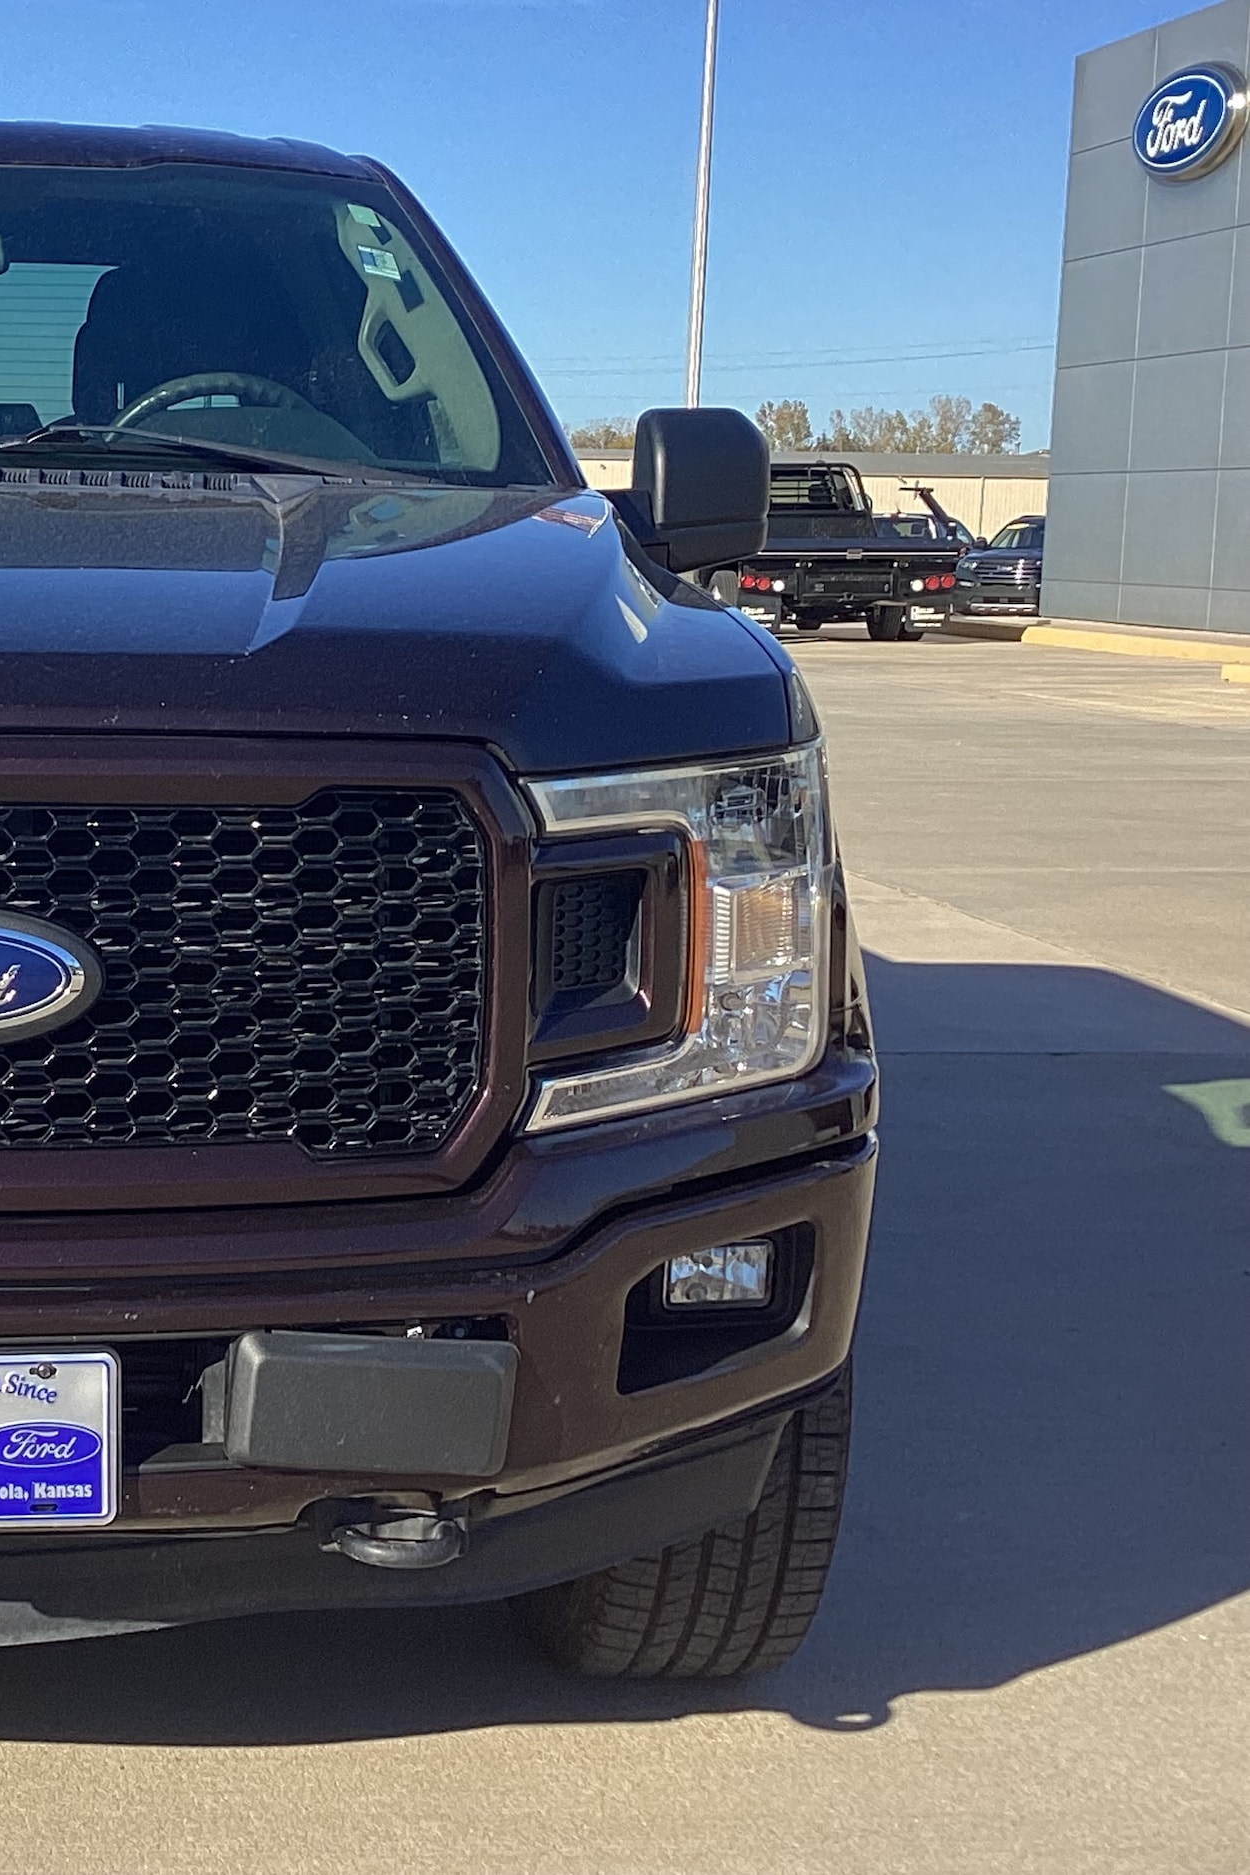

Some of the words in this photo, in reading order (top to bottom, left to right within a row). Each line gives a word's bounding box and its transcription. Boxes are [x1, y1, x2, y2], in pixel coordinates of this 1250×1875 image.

[1146, 90, 1207, 158] Ford
[6, 1373, 58, 1404] Since
[3, 1430, 77, 1460] Ford
[33, 1480, 93, 1500] Kansas
